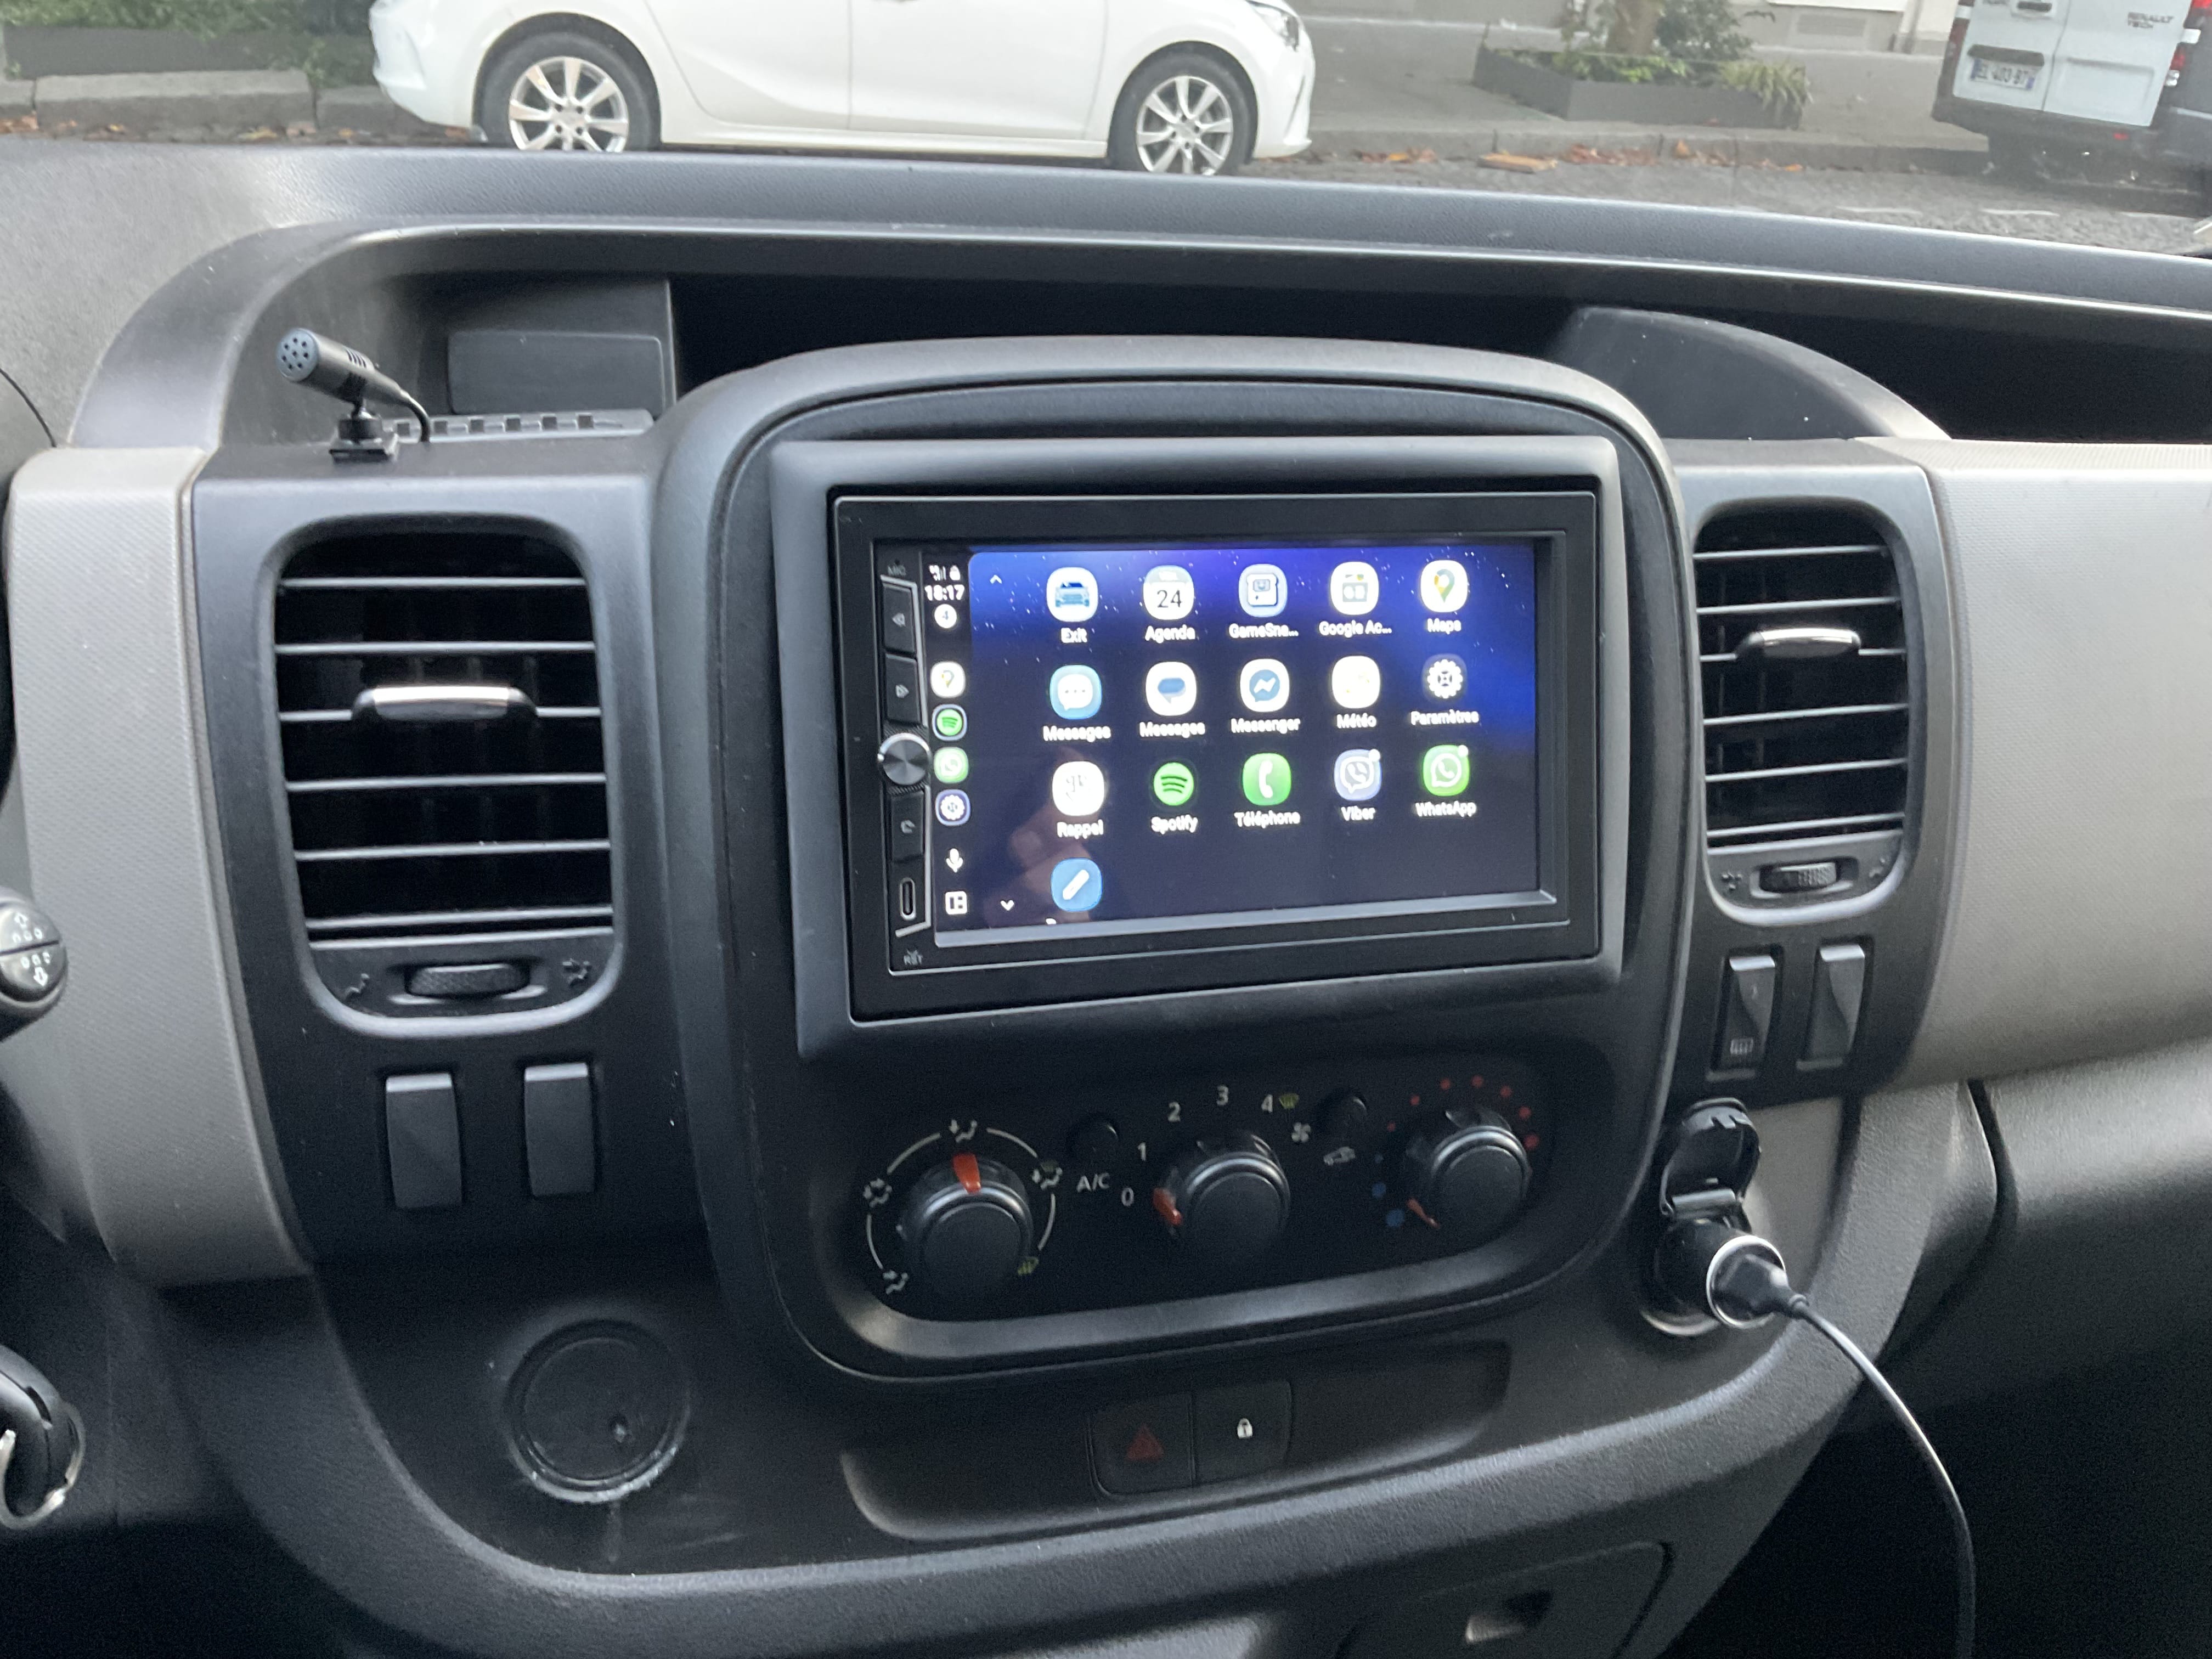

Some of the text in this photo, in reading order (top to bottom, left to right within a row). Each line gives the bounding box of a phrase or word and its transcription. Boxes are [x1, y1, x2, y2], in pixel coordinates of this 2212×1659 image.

[1157, 590, 1182, 608] 24
[1060, 627, 1088, 644] Exit
[1144, 624, 1195, 644] Agenda
[1318, 619, 1364, 638] Google
[1427, 618, 1462, 634] Maps
[1231, 718, 1301, 734] Messenger
[1336, 712, 1377, 729] Météo
[1410, 709, 1480, 726] Paramètres
[1043, 725, 1111, 743] Messages
[1139, 721, 1206, 738] Messages
[1340, 805, 1376, 821] Viber
[1415, 800, 1477, 817] WhatsApp
[1057, 819, 1104, 839] Rappel
[1151, 814, 1199, 834] Spotify
[1234, 810, 1301, 829] Téléphone
[1216, 1085, 1229, 1106] 3
[1260, 1093, 1274, 1113] 4
[1167, 1101, 1181, 1122] 2
[1137, 1142, 1147, 1161] 1
[1076, 1172, 1110, 1193] A/C
[1121, 1187, 1135, 1207] 0
